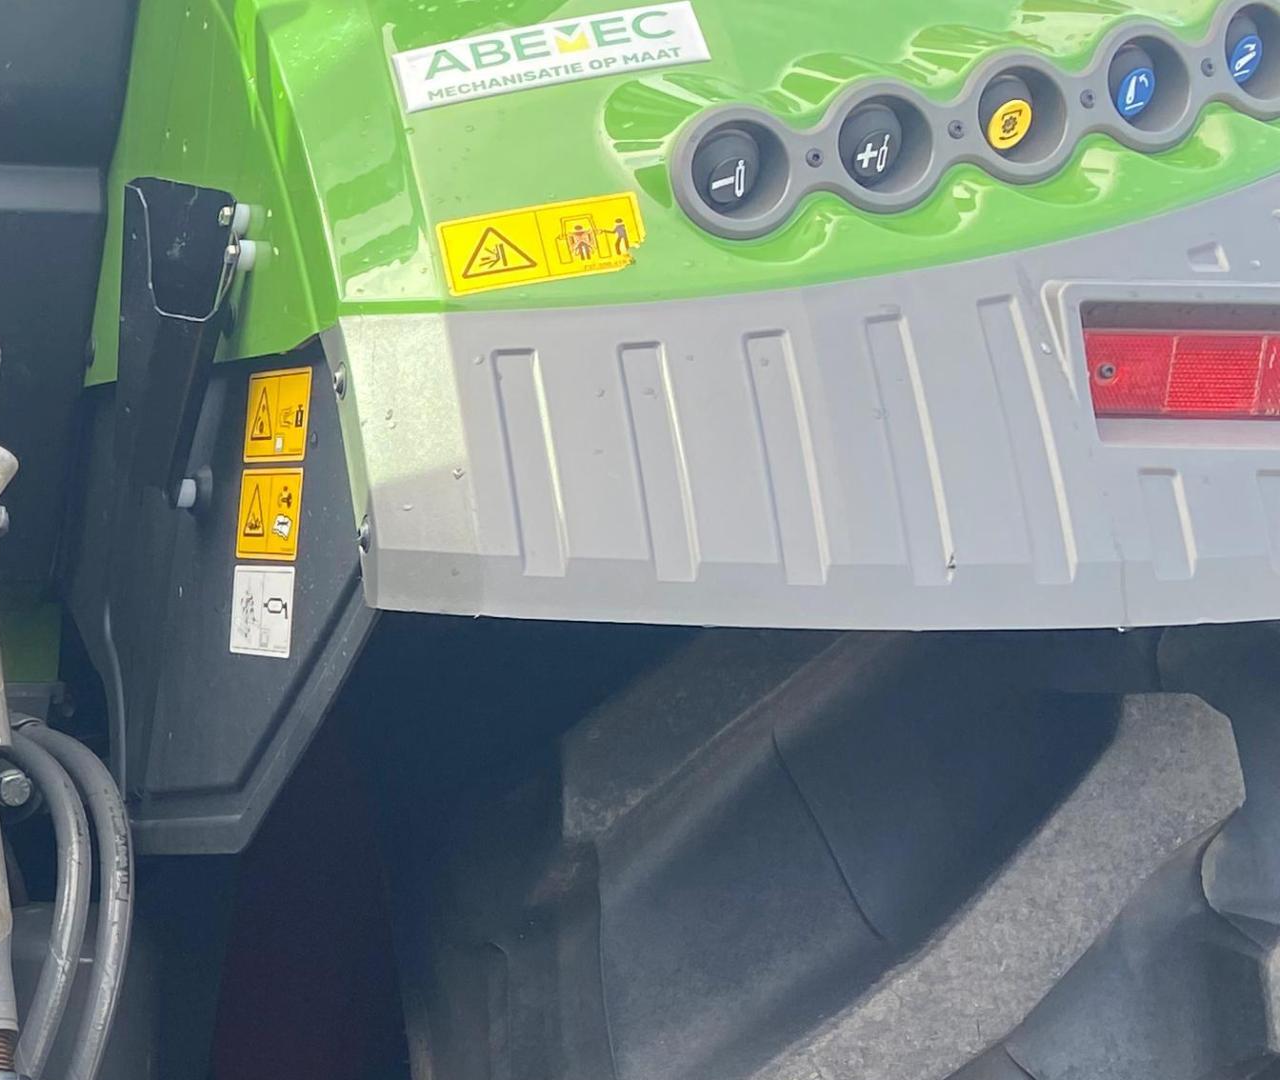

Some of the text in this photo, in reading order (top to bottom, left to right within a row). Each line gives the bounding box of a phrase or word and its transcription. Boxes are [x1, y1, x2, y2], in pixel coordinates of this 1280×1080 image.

[425, 11, 675, 80] ABEMEC
[427, 46, 682, 102] MECHANISATIE OP MAAT
